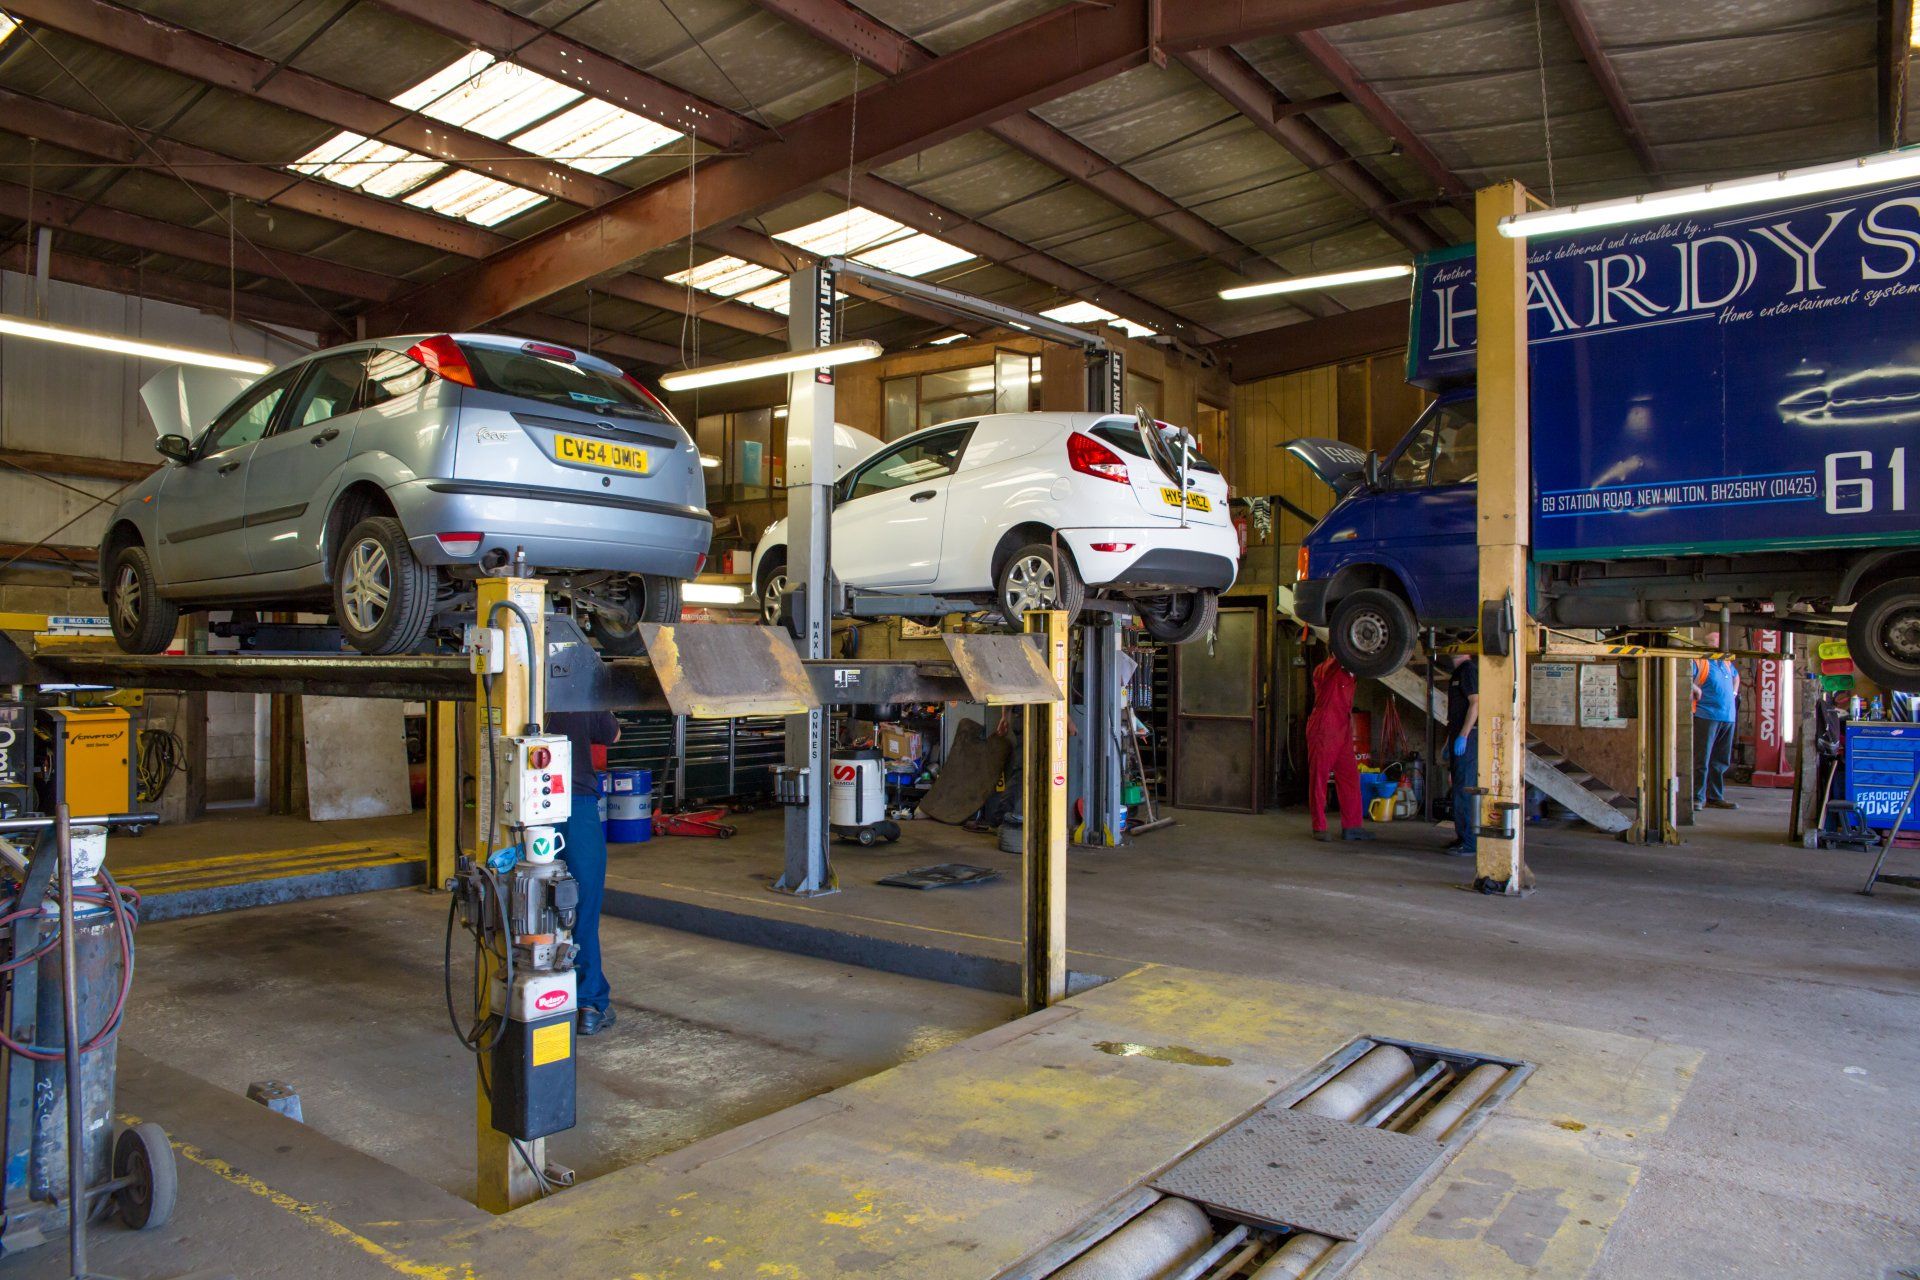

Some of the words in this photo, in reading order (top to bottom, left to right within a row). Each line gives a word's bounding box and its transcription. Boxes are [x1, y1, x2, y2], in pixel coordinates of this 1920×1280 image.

[1432, 265, 1472, 284] Another
[1554, 242, 1603, 260] delivered
[1607, 232, 1628, 250] and
[1629, 222, 1679, 245] installed
[1683, 219, 1712, 239] by...
[1432, 195, 1920, 351] HARDYS
[820, 268, 833, 306] LIFT
[1718, 305, 1754, 325] Home
[1759, 288, 1860, 318] entertainment
[819, 307, 832, 375] RTARY
[1113, 351, 1121, 381] LIFT
[563, 438, 606, 462] CV54
[1541, 496, 1556, 513] 69
[1558, 492, 1600, 510] STATION
[1637, 489, 1662, 507] NEW
[1711, 481, 1767, 501] BH256HY
[1769, 476, 1817, 497] (01425)
[1824, 447, 1905, 515] 61
